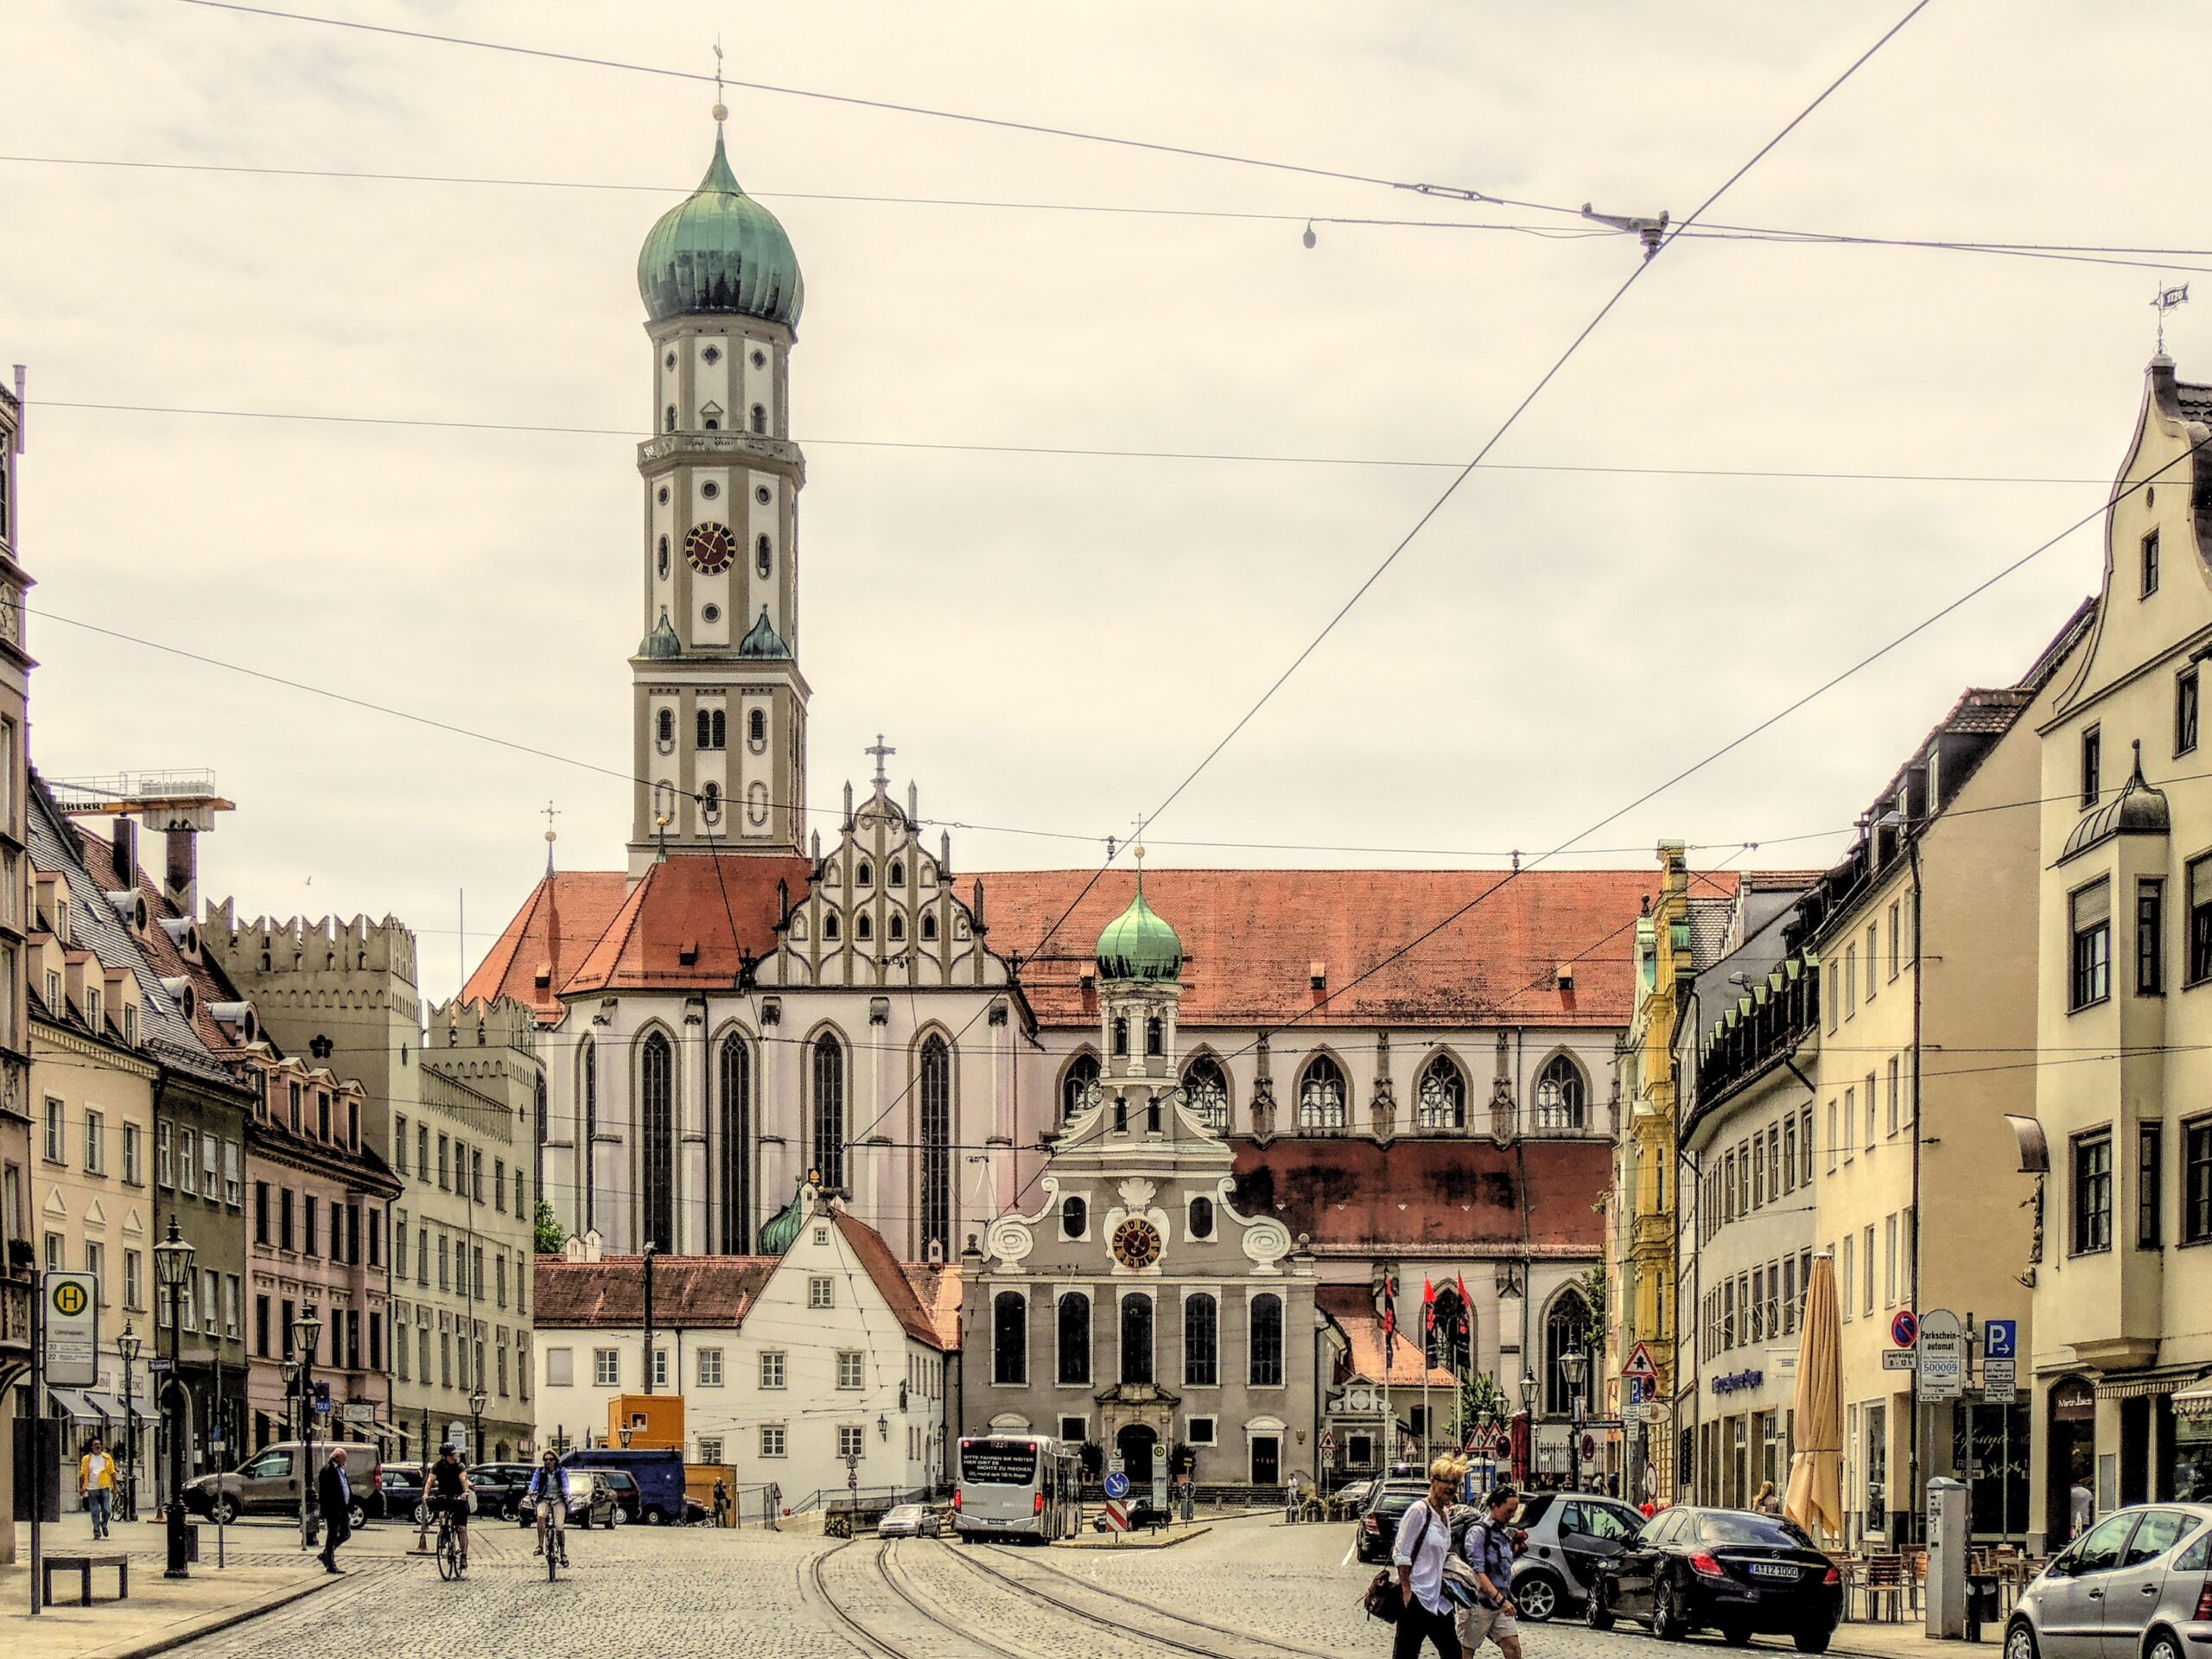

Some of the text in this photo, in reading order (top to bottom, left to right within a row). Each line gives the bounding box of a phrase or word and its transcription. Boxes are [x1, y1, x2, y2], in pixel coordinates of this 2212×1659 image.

[2166, 290, 2183, 303] 1720
[63, 1288, 78, 1308] H
[1921, 1331, 1961, 1340] Parkschein-
[1988, 1325, 2006, 1354] P
[1927, 1342, 1955, 1351] automat
[1923, 1363, 1958, 1372] 500009
[1631, 1380, 1638, 1402] P
